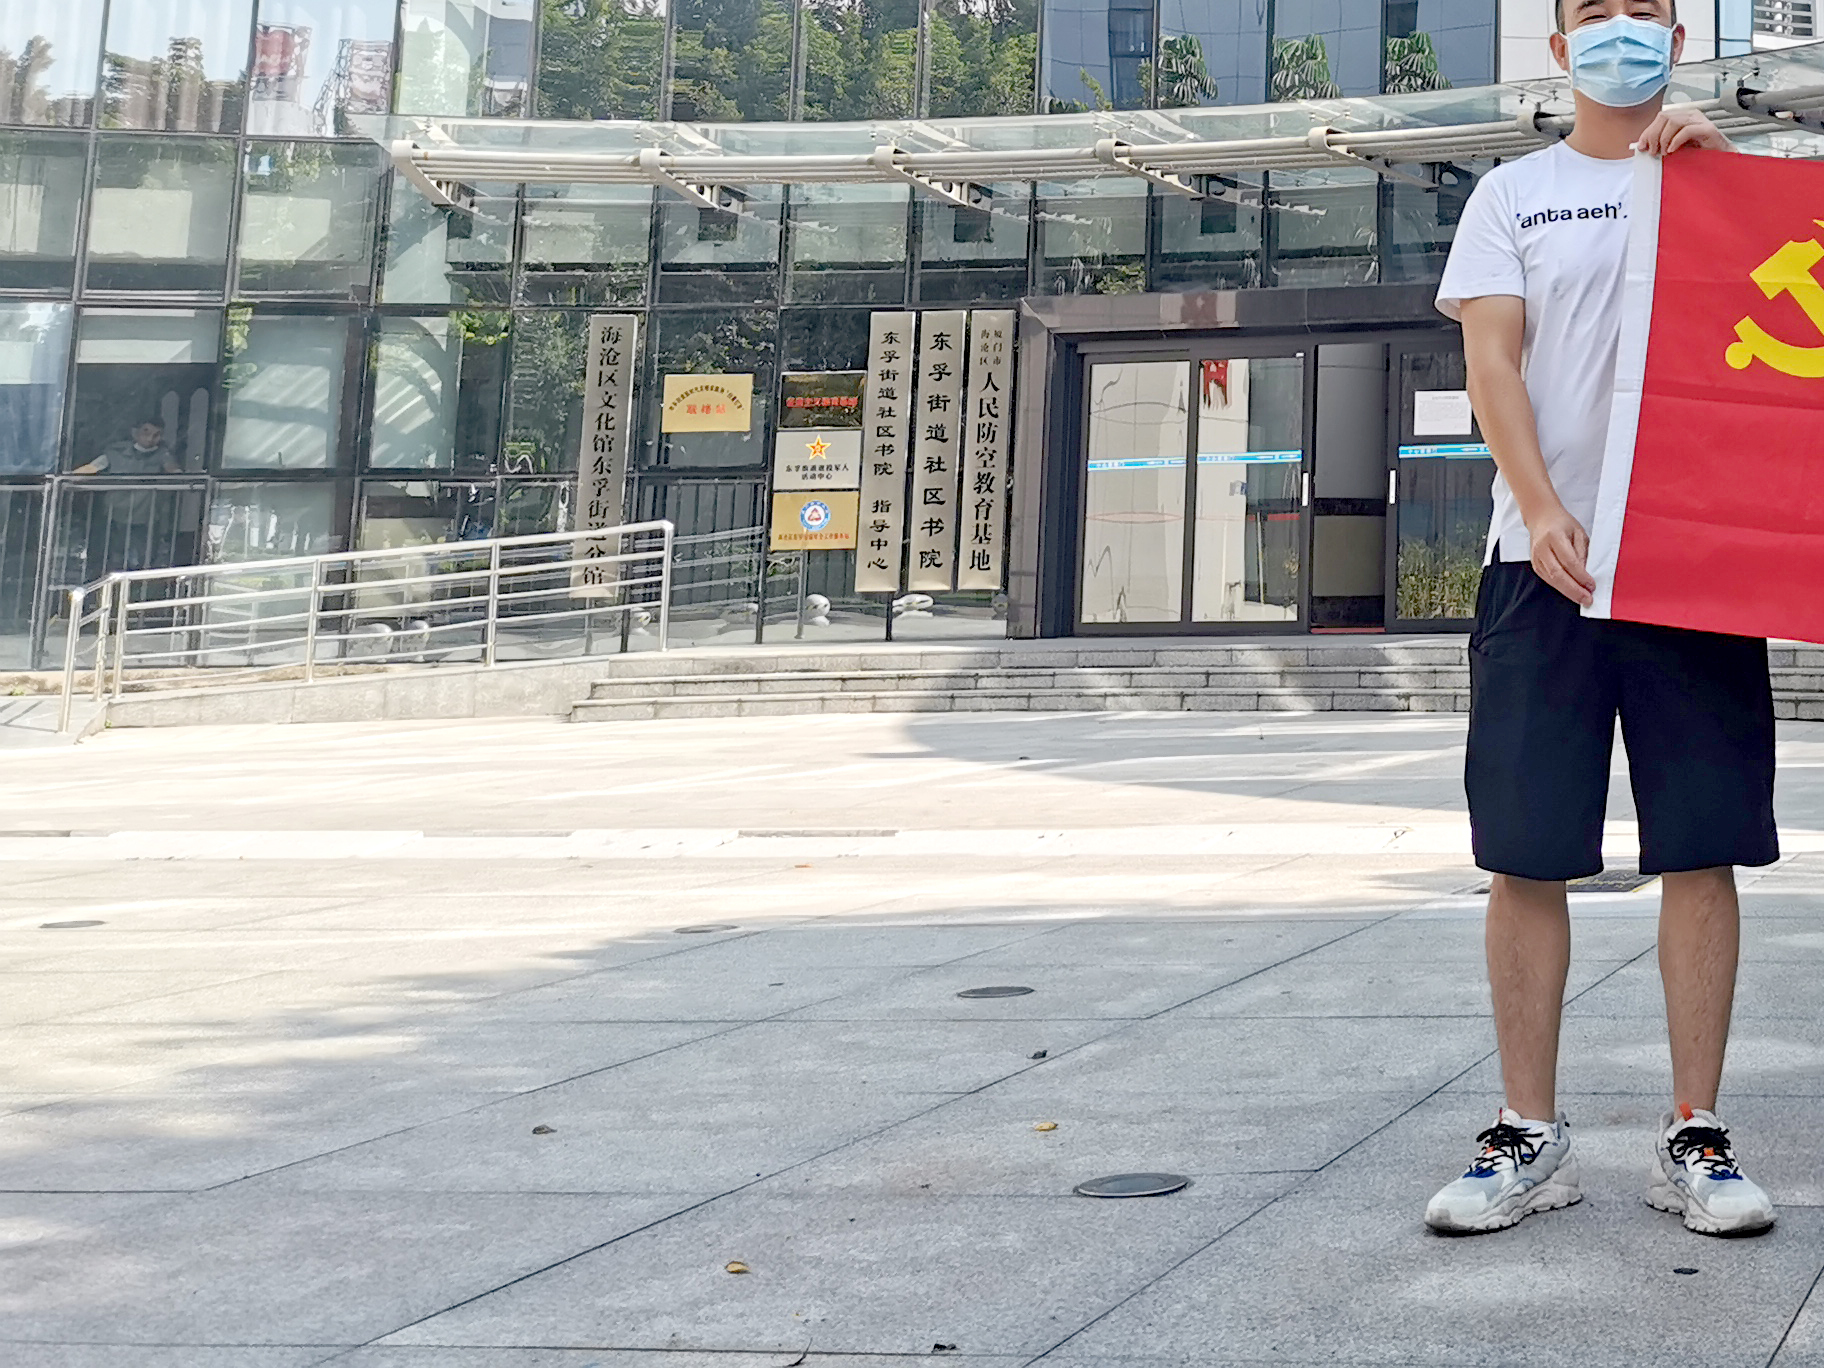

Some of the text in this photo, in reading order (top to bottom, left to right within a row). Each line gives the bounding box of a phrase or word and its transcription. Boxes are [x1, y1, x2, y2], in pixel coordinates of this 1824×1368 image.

[919, 332, 953, 569] 东孚街道社区书院
[969, 371, 1001, 571] 人民防空教育基地
